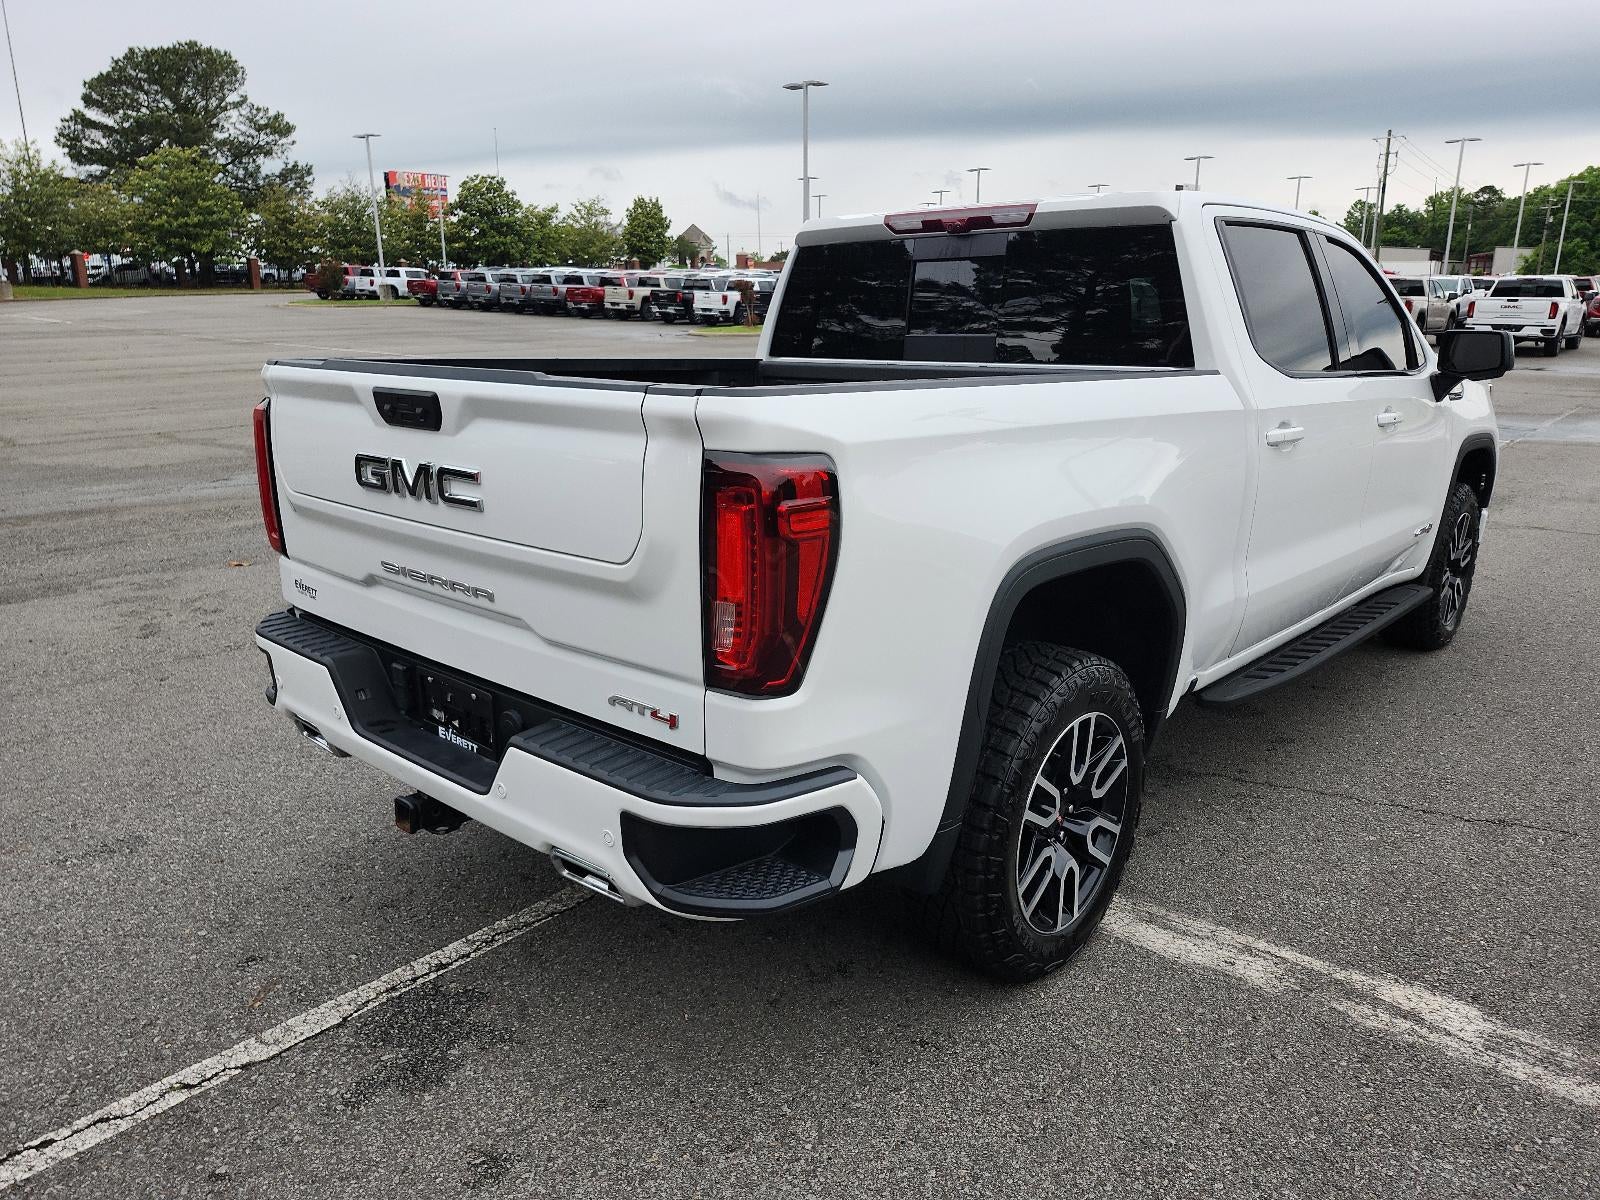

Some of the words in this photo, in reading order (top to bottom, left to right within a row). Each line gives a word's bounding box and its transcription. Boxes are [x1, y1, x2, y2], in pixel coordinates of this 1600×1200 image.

[425, 174, 447, 188] HEE
[355, 452, 485, 513] GMC
[294, 578, 317, 597] EVERETT
[380, 560, 496, 603] SIERRA
[607, 694, 680, 730] AT4
[438, 725, 478, 753] EVERETT
